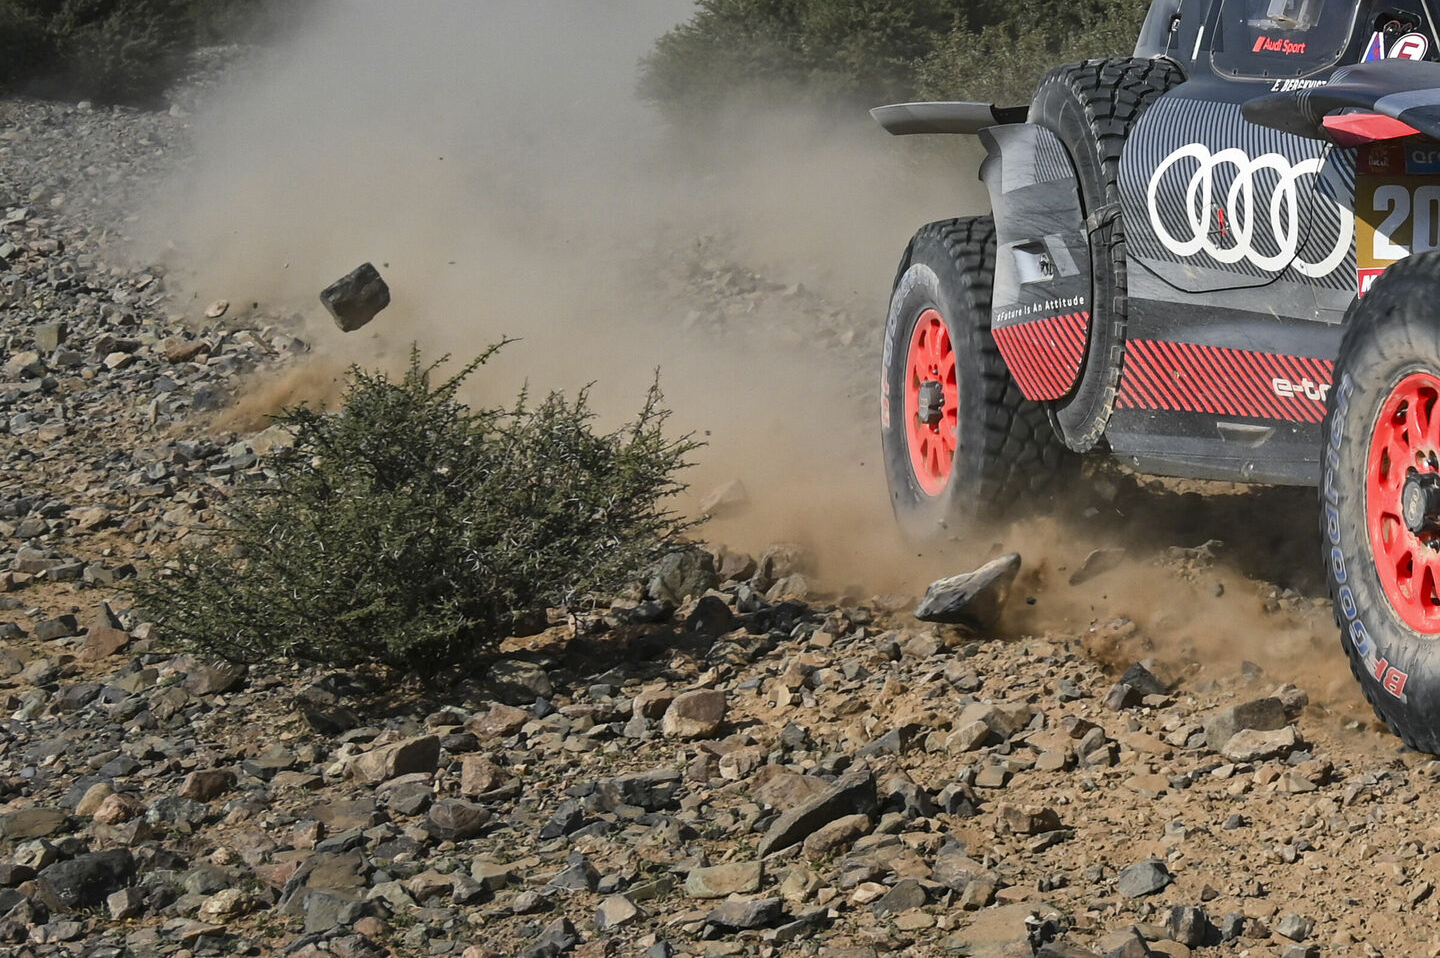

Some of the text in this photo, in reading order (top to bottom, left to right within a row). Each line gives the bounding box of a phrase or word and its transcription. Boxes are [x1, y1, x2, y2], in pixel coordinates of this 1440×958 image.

[1263, 37, 1307, 55] Audi Sport
[1270, 78, 1281, 92] E.
[1044, 294, 1085, 310] Attitude
